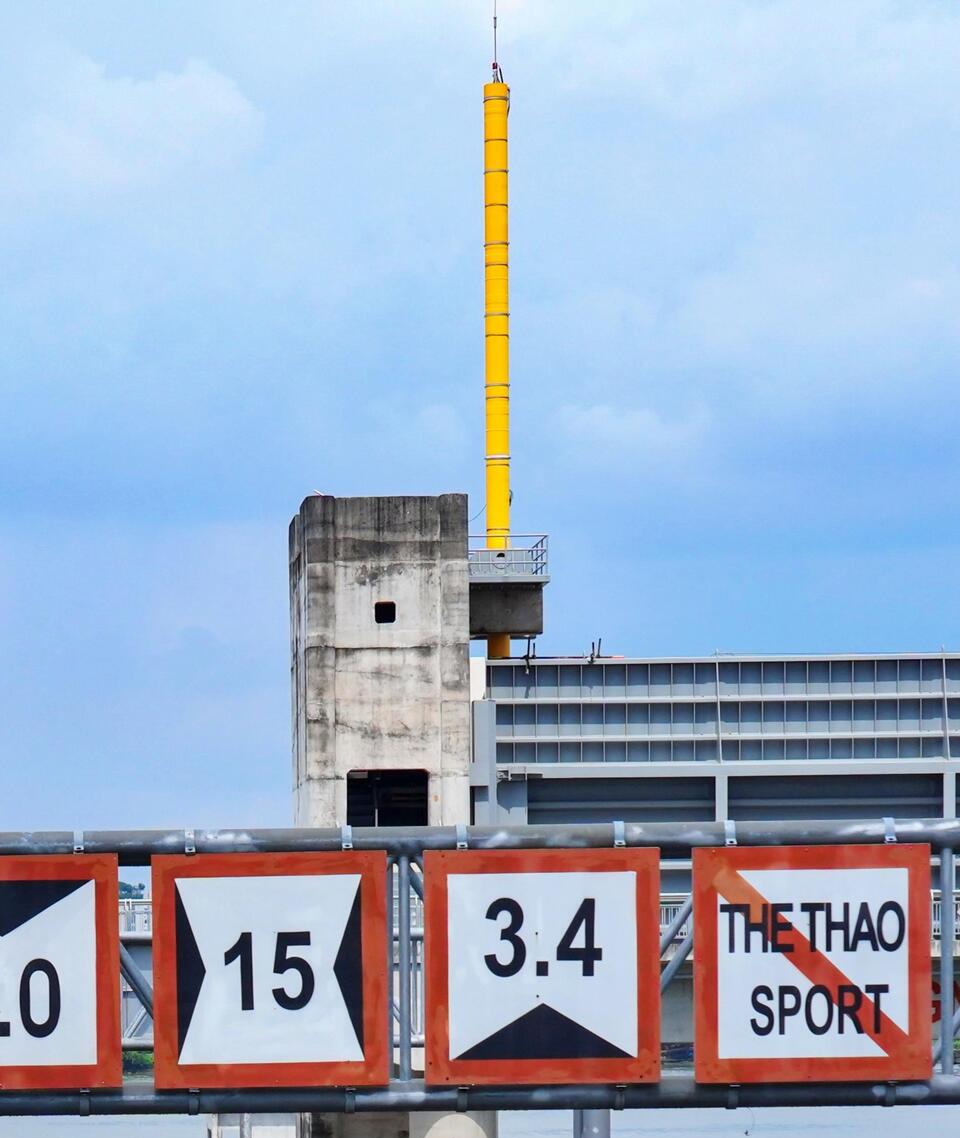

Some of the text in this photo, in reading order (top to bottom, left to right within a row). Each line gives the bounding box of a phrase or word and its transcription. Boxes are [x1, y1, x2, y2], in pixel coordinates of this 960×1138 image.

[484, 897, 603, 978] 3.4
[719, 900, 906, 953] THE THAO
[224, 931, 315, 1011] 15
[750, 984, 890, 1036] SPORT
